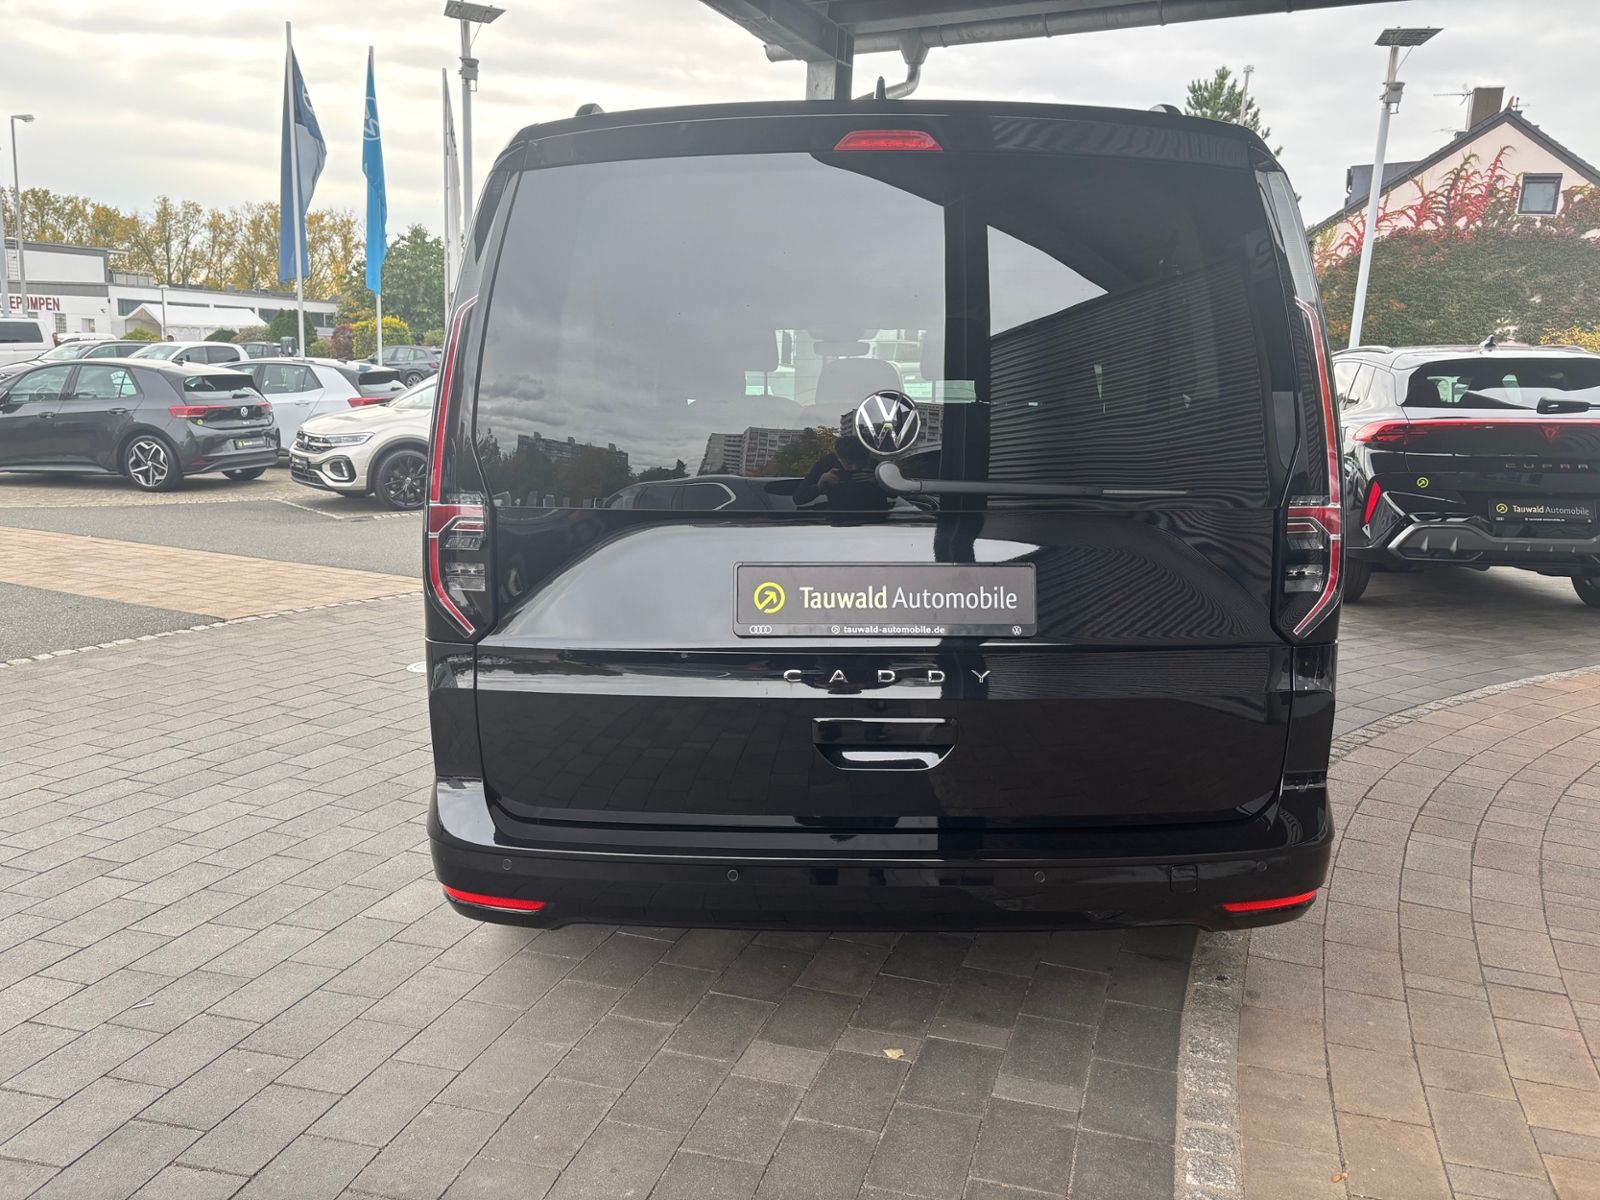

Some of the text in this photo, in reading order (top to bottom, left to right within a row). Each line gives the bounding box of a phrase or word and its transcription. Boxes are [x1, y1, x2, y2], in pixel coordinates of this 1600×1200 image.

[1512, 505, 1590, 516] Tauwald Automobile
[800, 585, 1018, 609] Tauwald Automobile
[843, 625, 945, 634] tauwald-automobile.de
[783, 669, 991, 684] CADDY
